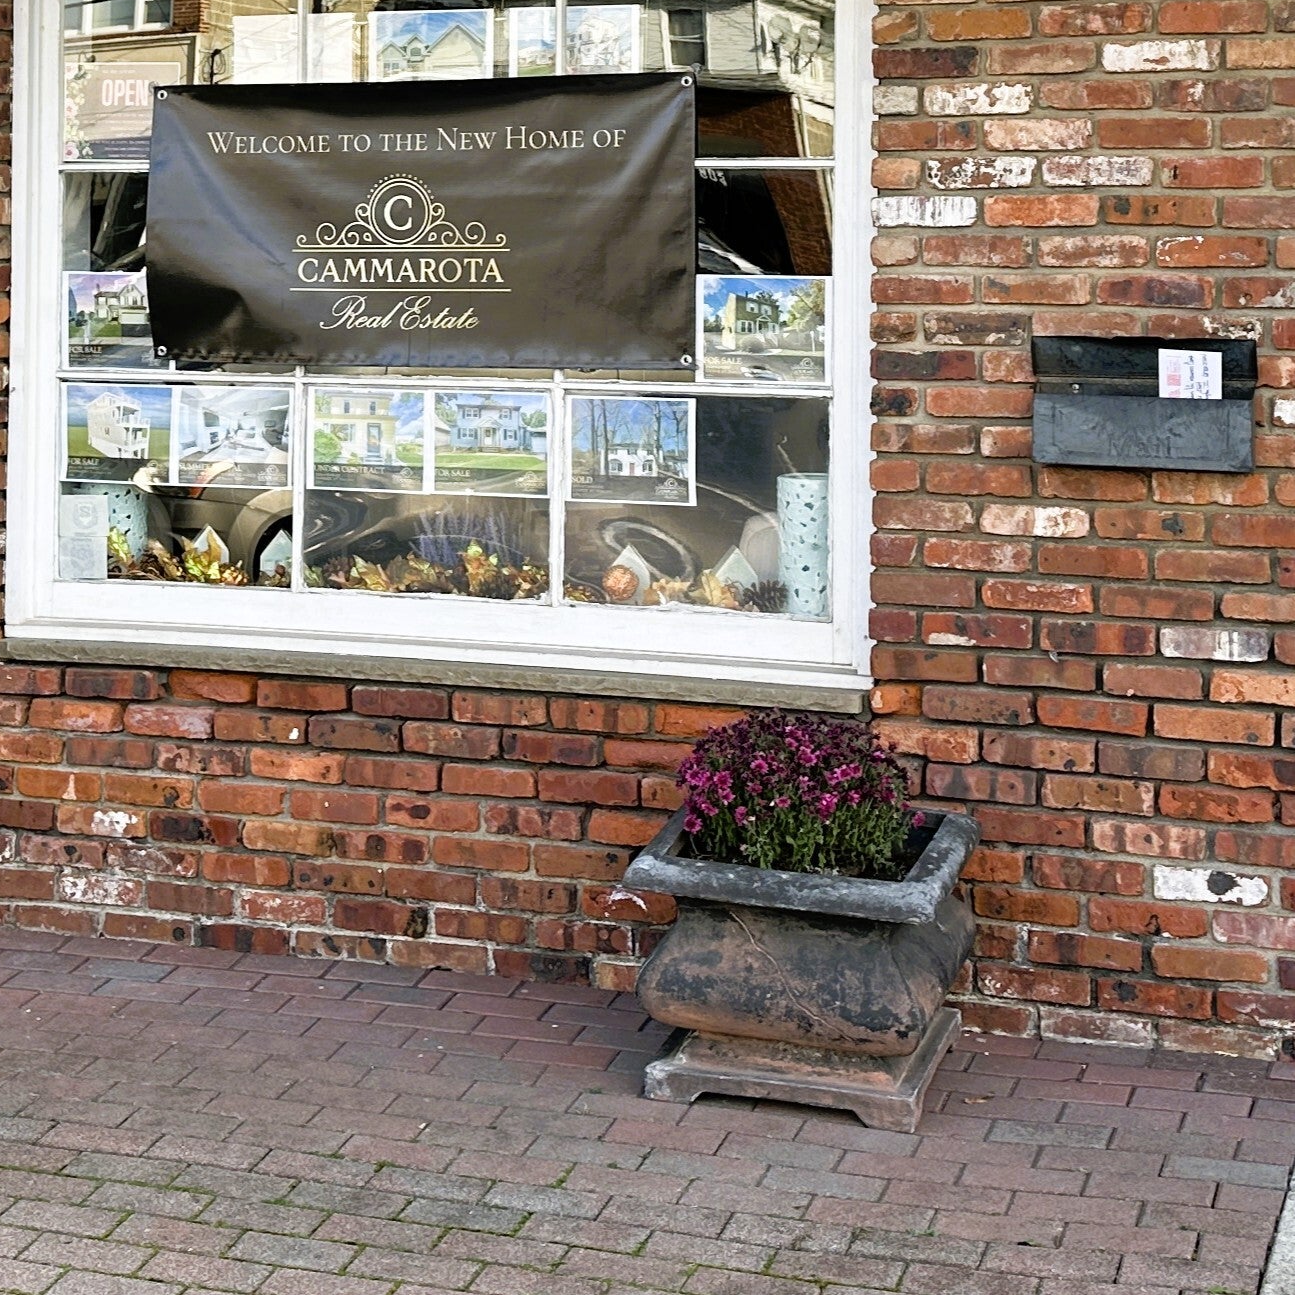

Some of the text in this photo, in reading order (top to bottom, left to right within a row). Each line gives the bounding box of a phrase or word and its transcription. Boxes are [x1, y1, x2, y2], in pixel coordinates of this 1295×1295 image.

[101, 79, 149, 107] OPEN
[207, 125, 627, 154] WELCOME TO THE NEW HOME OF
[384, 195, 413, 231] C
[297, 257, 505, 284] CAMMAROTA
[319, 295, 480, 330] Real Estate
[84, 346, 102, 354] SALE
[704, 356, 743, 365] FOR SALE
[314, 464, 385, 474] UNDER CONTRACT
[451, 469, 471, 477] SALE
[572, 476, 593, 484] SOLD
